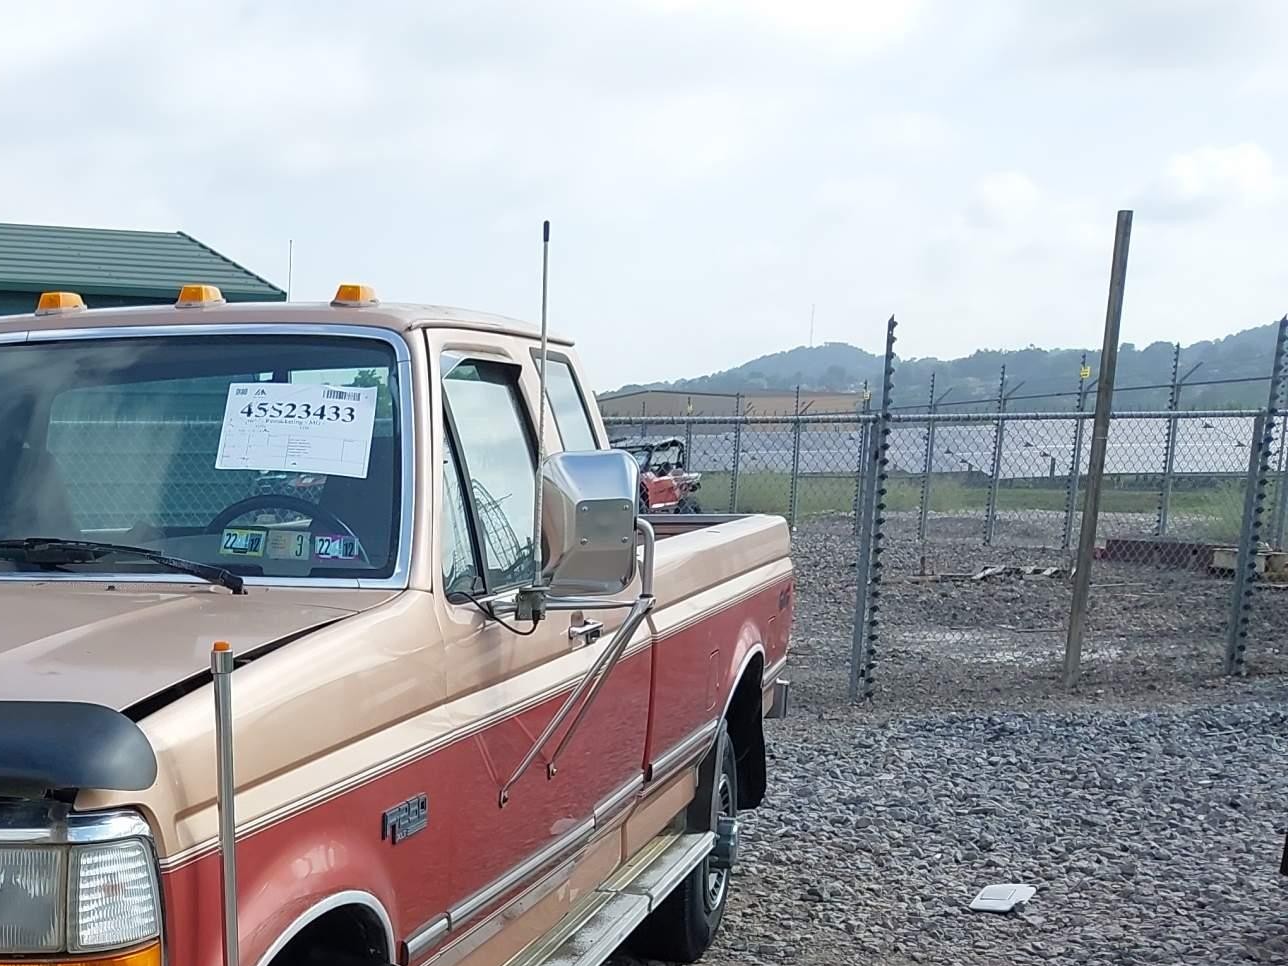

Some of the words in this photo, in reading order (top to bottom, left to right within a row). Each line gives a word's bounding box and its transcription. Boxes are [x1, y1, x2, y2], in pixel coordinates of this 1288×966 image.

[240, 402, 355, 423] 45523433
[224, 533, 238, 549] 22
[295, 534, 304, 557] 3
[318, 539, 331, 556] 22
[343, 542, 354, 557] 12
